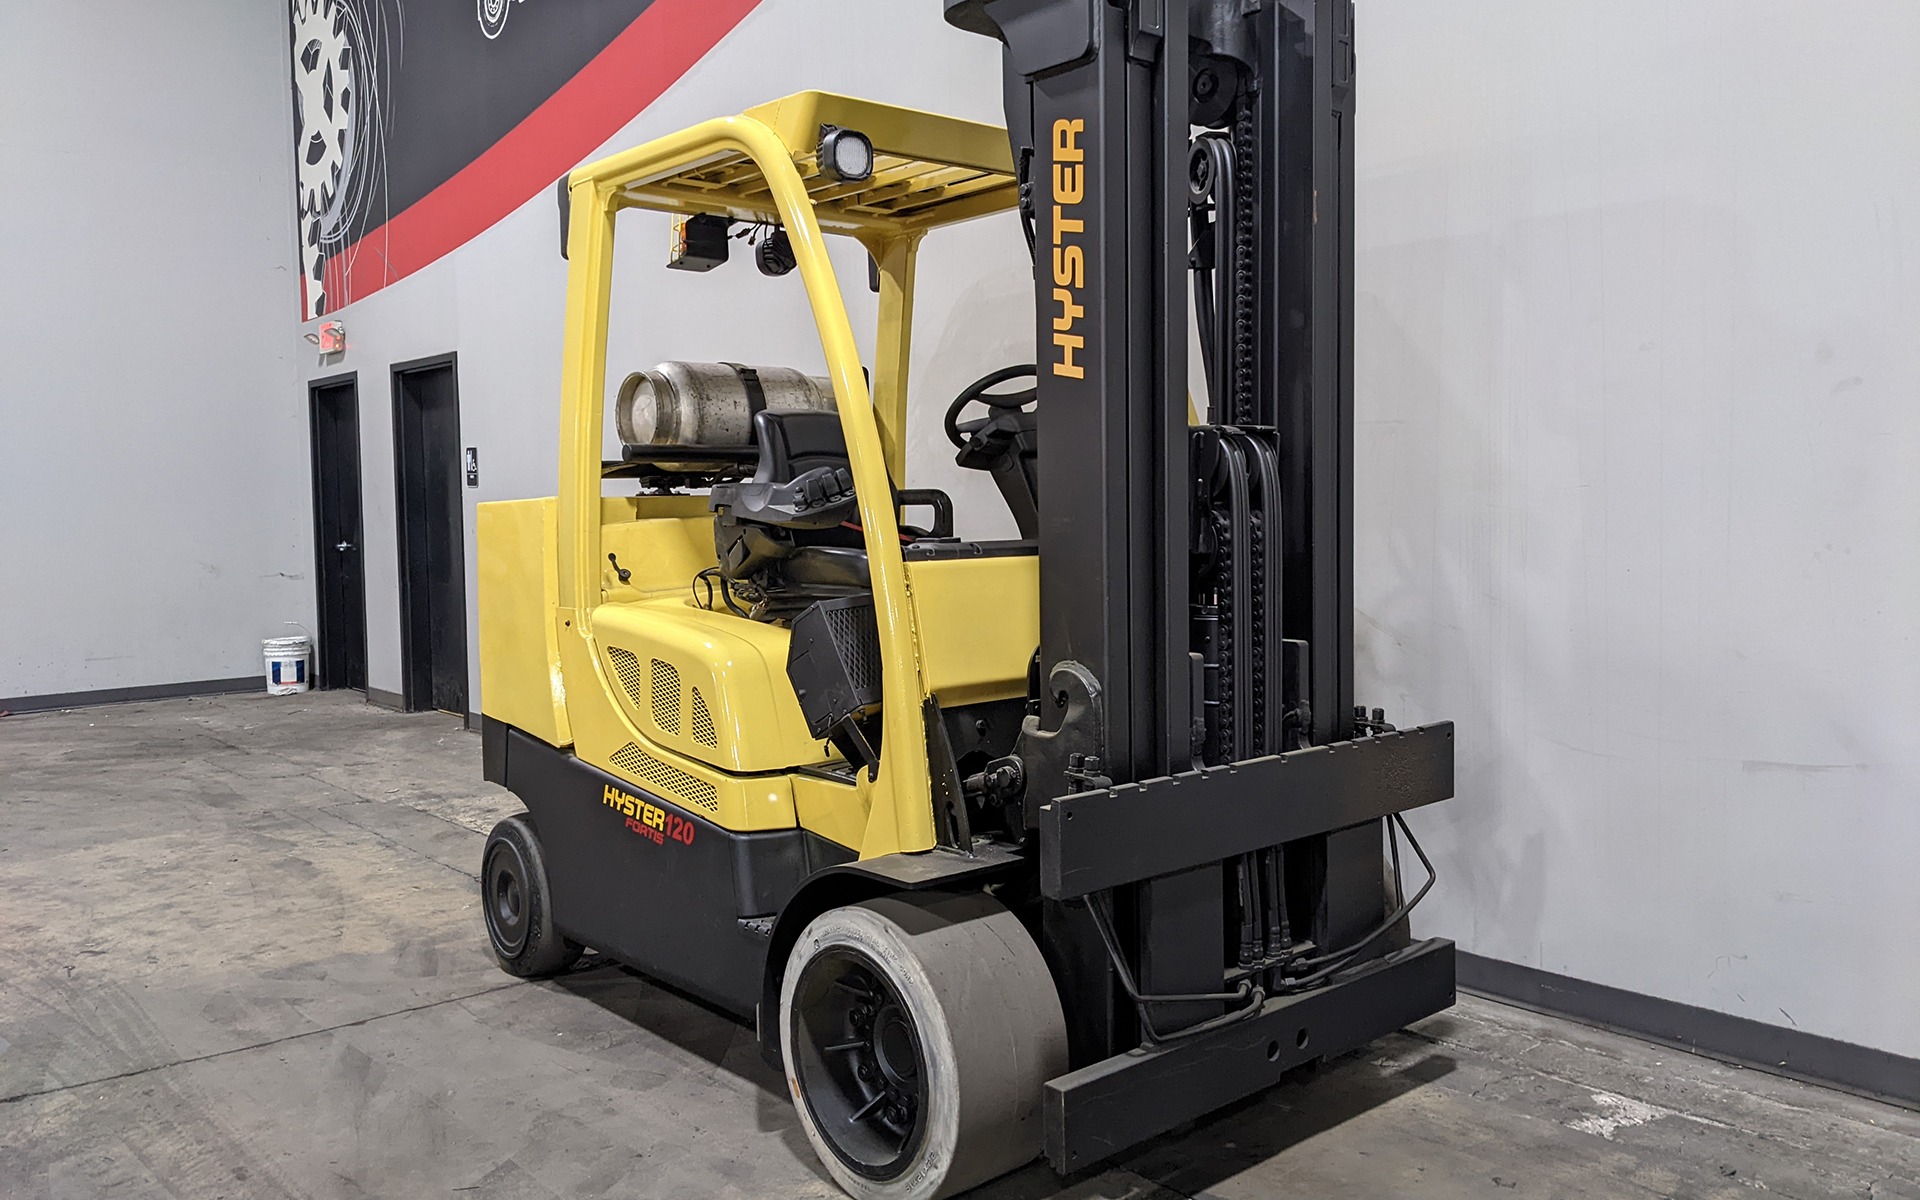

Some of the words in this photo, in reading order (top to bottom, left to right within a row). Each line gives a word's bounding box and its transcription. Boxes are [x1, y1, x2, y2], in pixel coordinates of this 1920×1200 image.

[1053, 118, 1084, 380] HYSTER
[602, 784, 666, 831] HYSTER
[665, 813, 695, 845] 120
[625, 817, 665, 845] FORTIS
